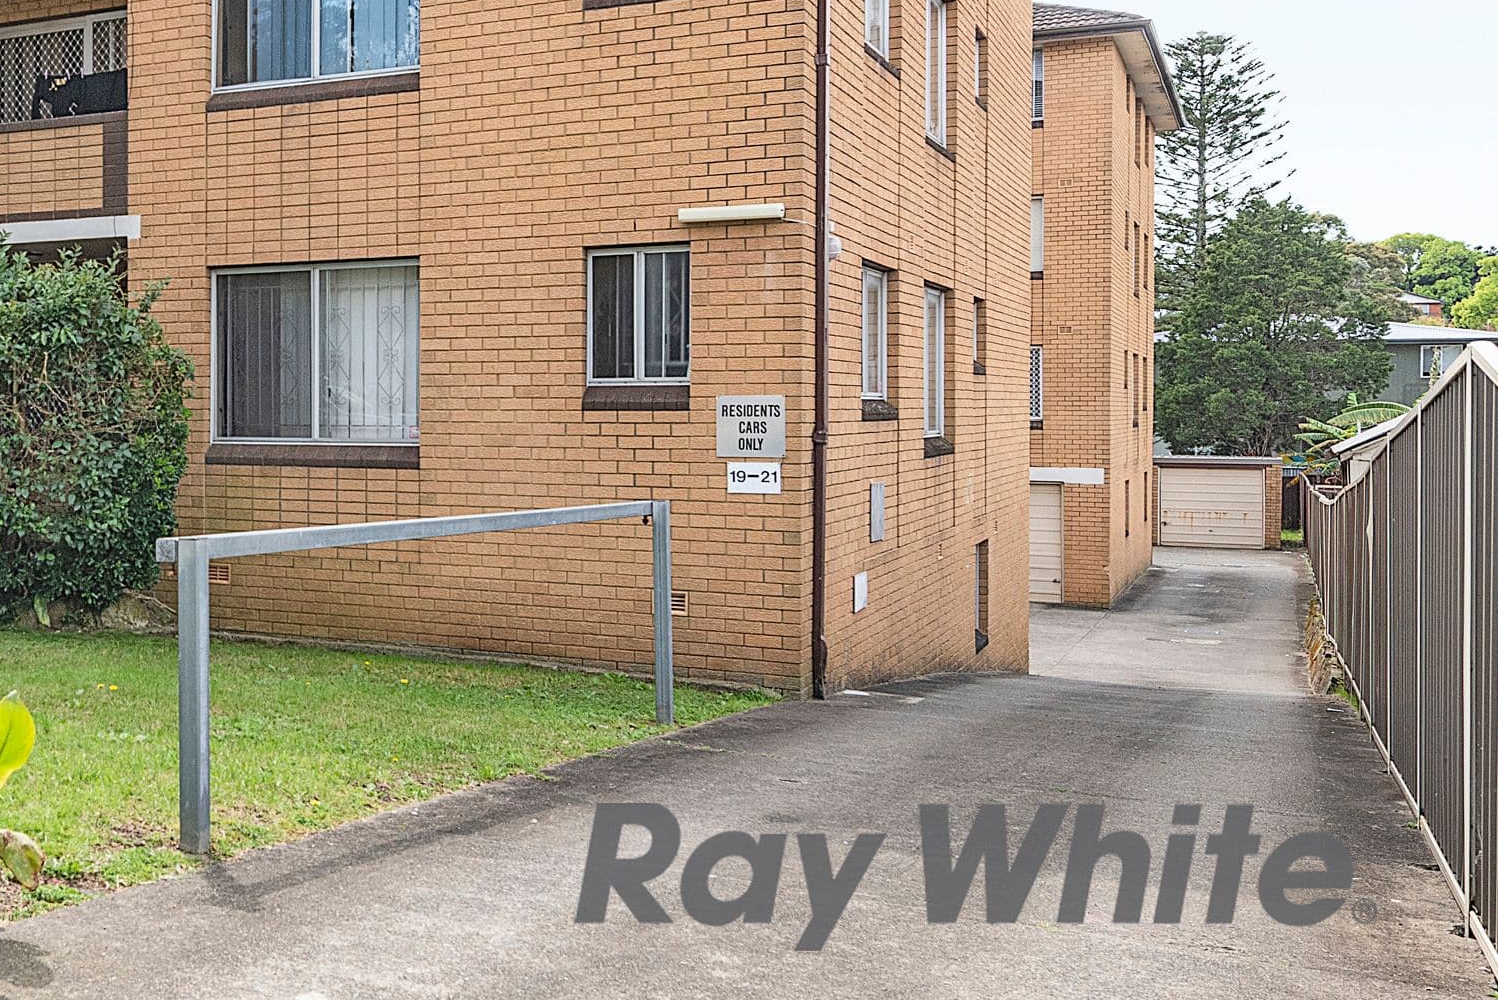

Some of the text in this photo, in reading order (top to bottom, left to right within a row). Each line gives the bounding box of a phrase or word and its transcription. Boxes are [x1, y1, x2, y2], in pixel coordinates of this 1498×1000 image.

[721, 404, 781, 418] RESIDENTS
[738, 420, 768, 434] CARS
[738, 437, 764, 451] ONLY
[729, 470, 777, 483] 19-21
